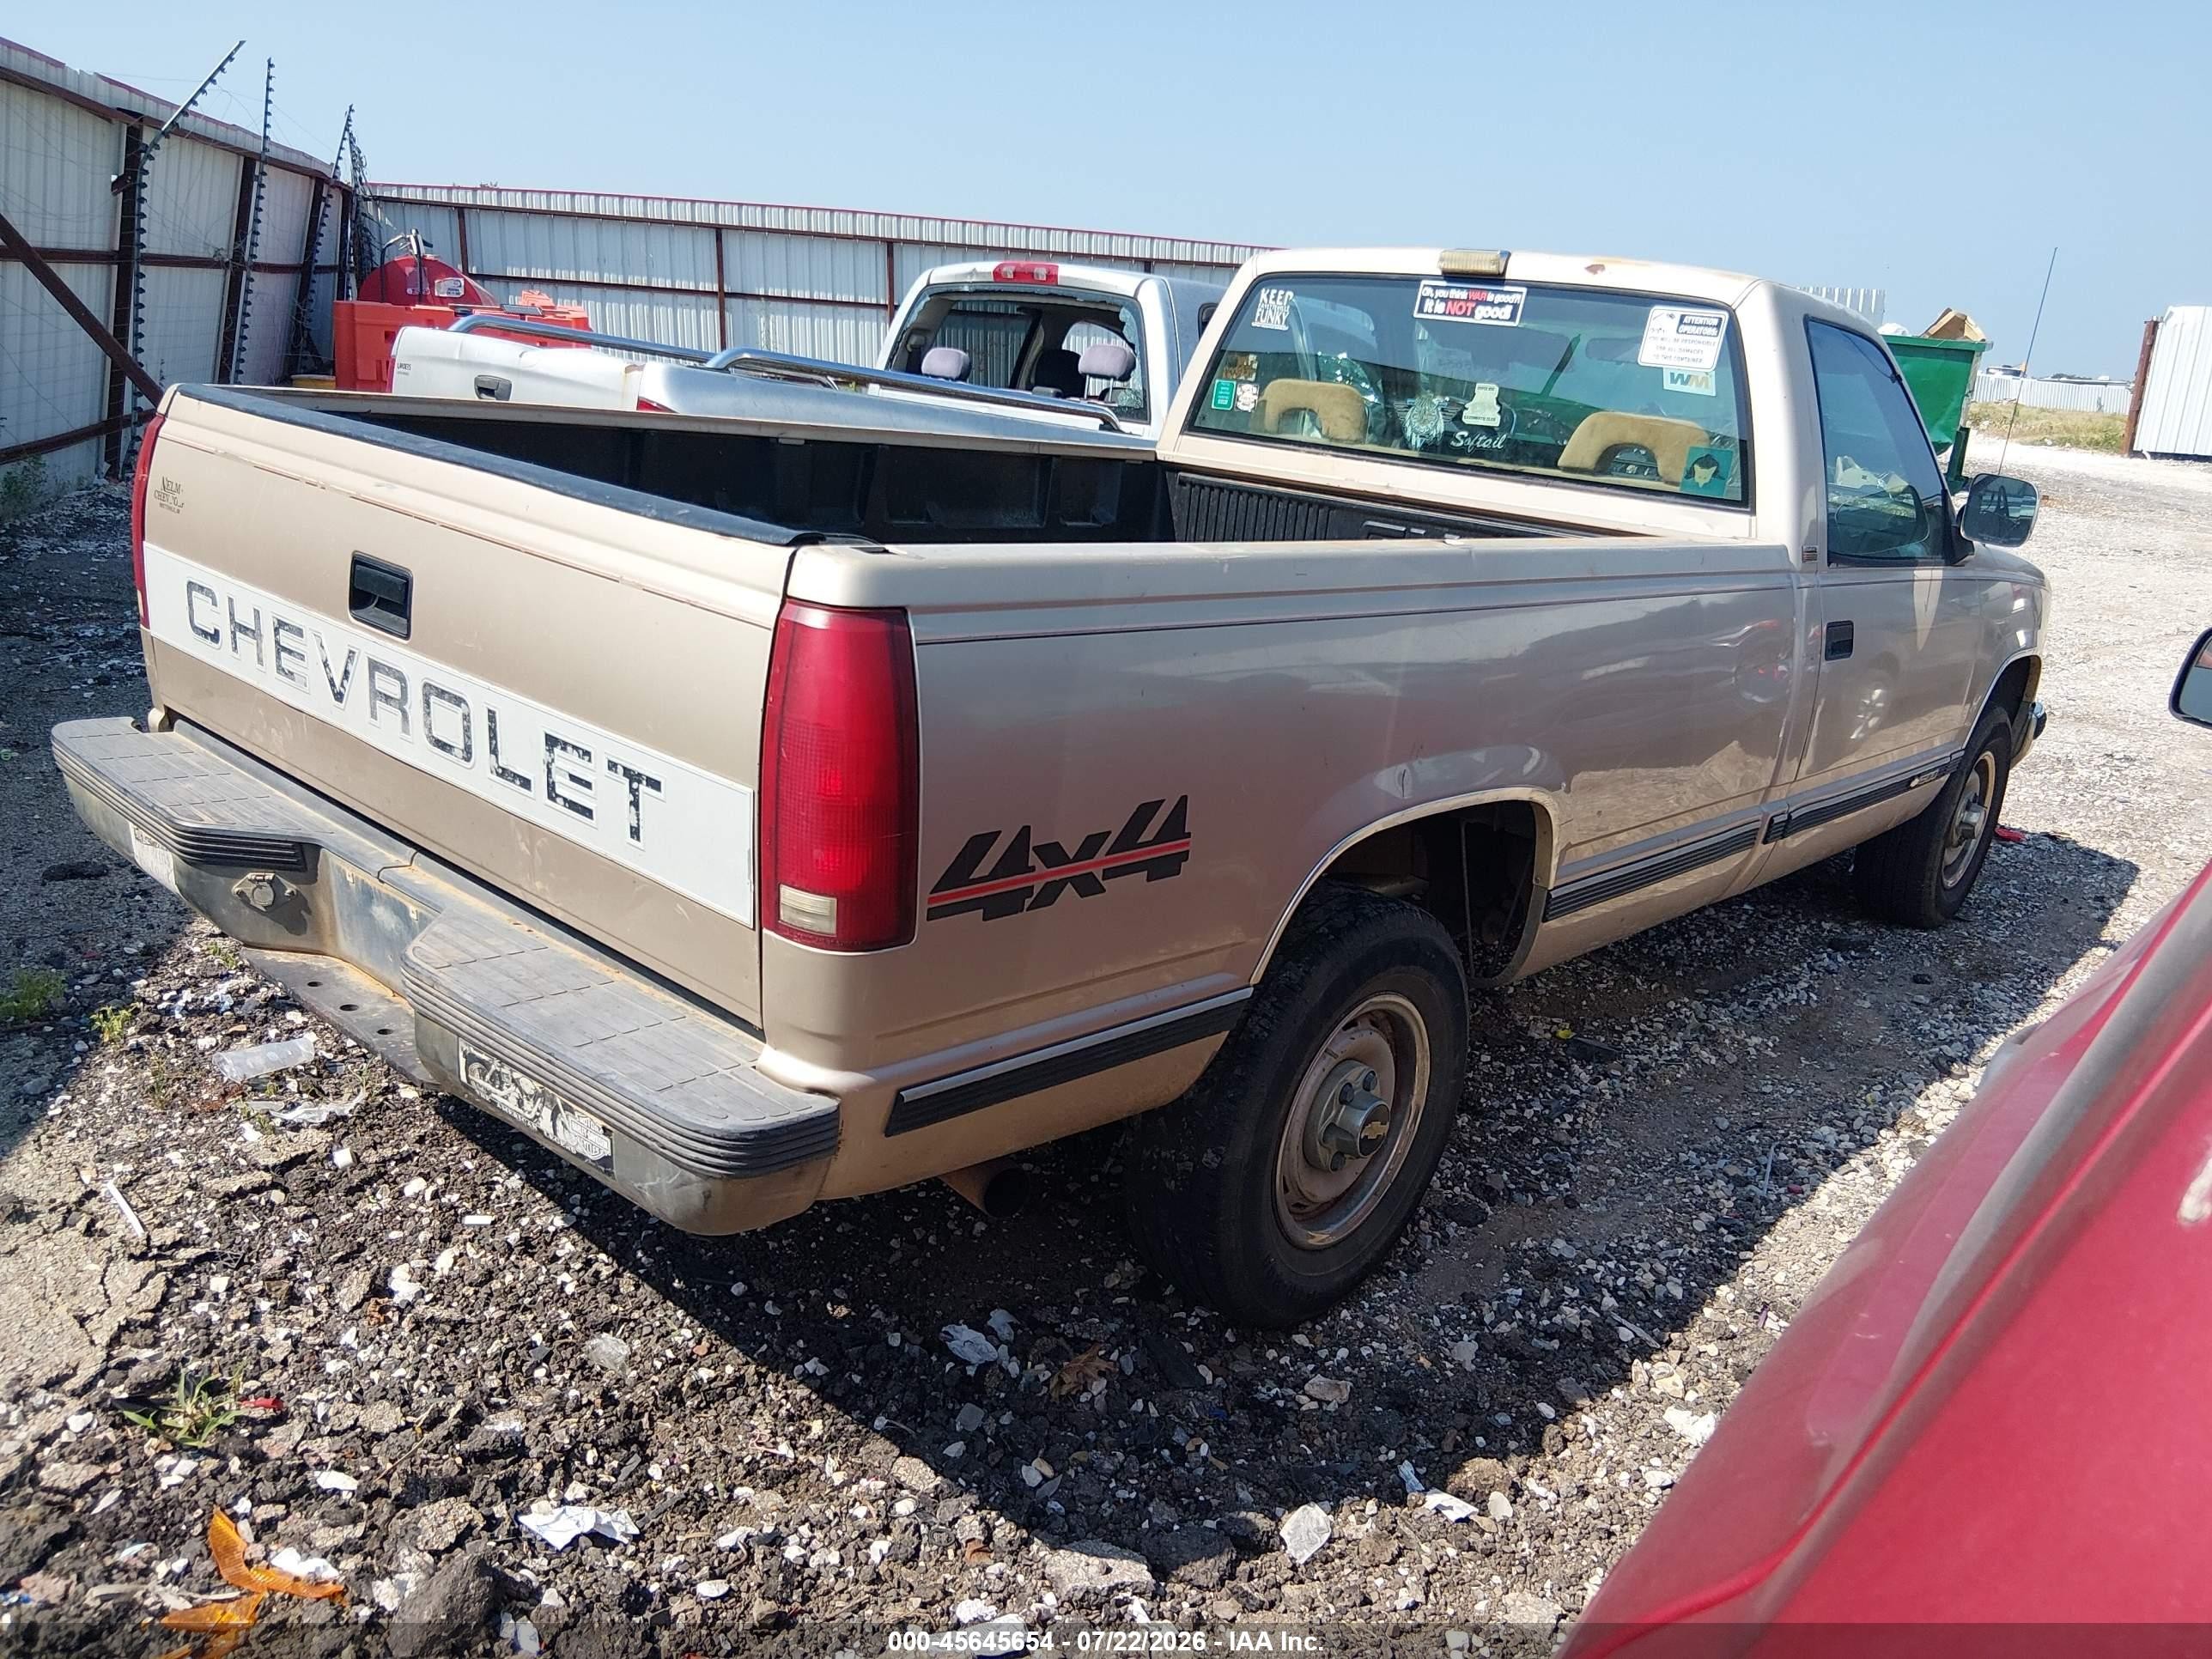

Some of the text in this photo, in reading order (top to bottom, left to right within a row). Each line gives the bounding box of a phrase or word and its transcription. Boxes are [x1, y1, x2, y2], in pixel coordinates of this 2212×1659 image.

[1260, 288, 1294, 306] KEEP
[1421, 287, 1433, 298] Oh,
[1434, 289, 1449, 299] you
[1449, 288, 1468, 300] think
[1468, 290, 1487, 301] WAR
[1486, 292, 1494, 302] is
[1255, 308, 1290, 325] FUNKY
[1434, 300, 1446, 313] is
[1446, 301, 1476, 316] NOT
[1474, 305, 1513, 320] good!
[1683, 316, 1718, 325] ATTENTION
[1669, 372, 1710, 389] WM
[1449, 431, 1507, 454] Softail
[186, 579, 663, 843] CHEVROLET
